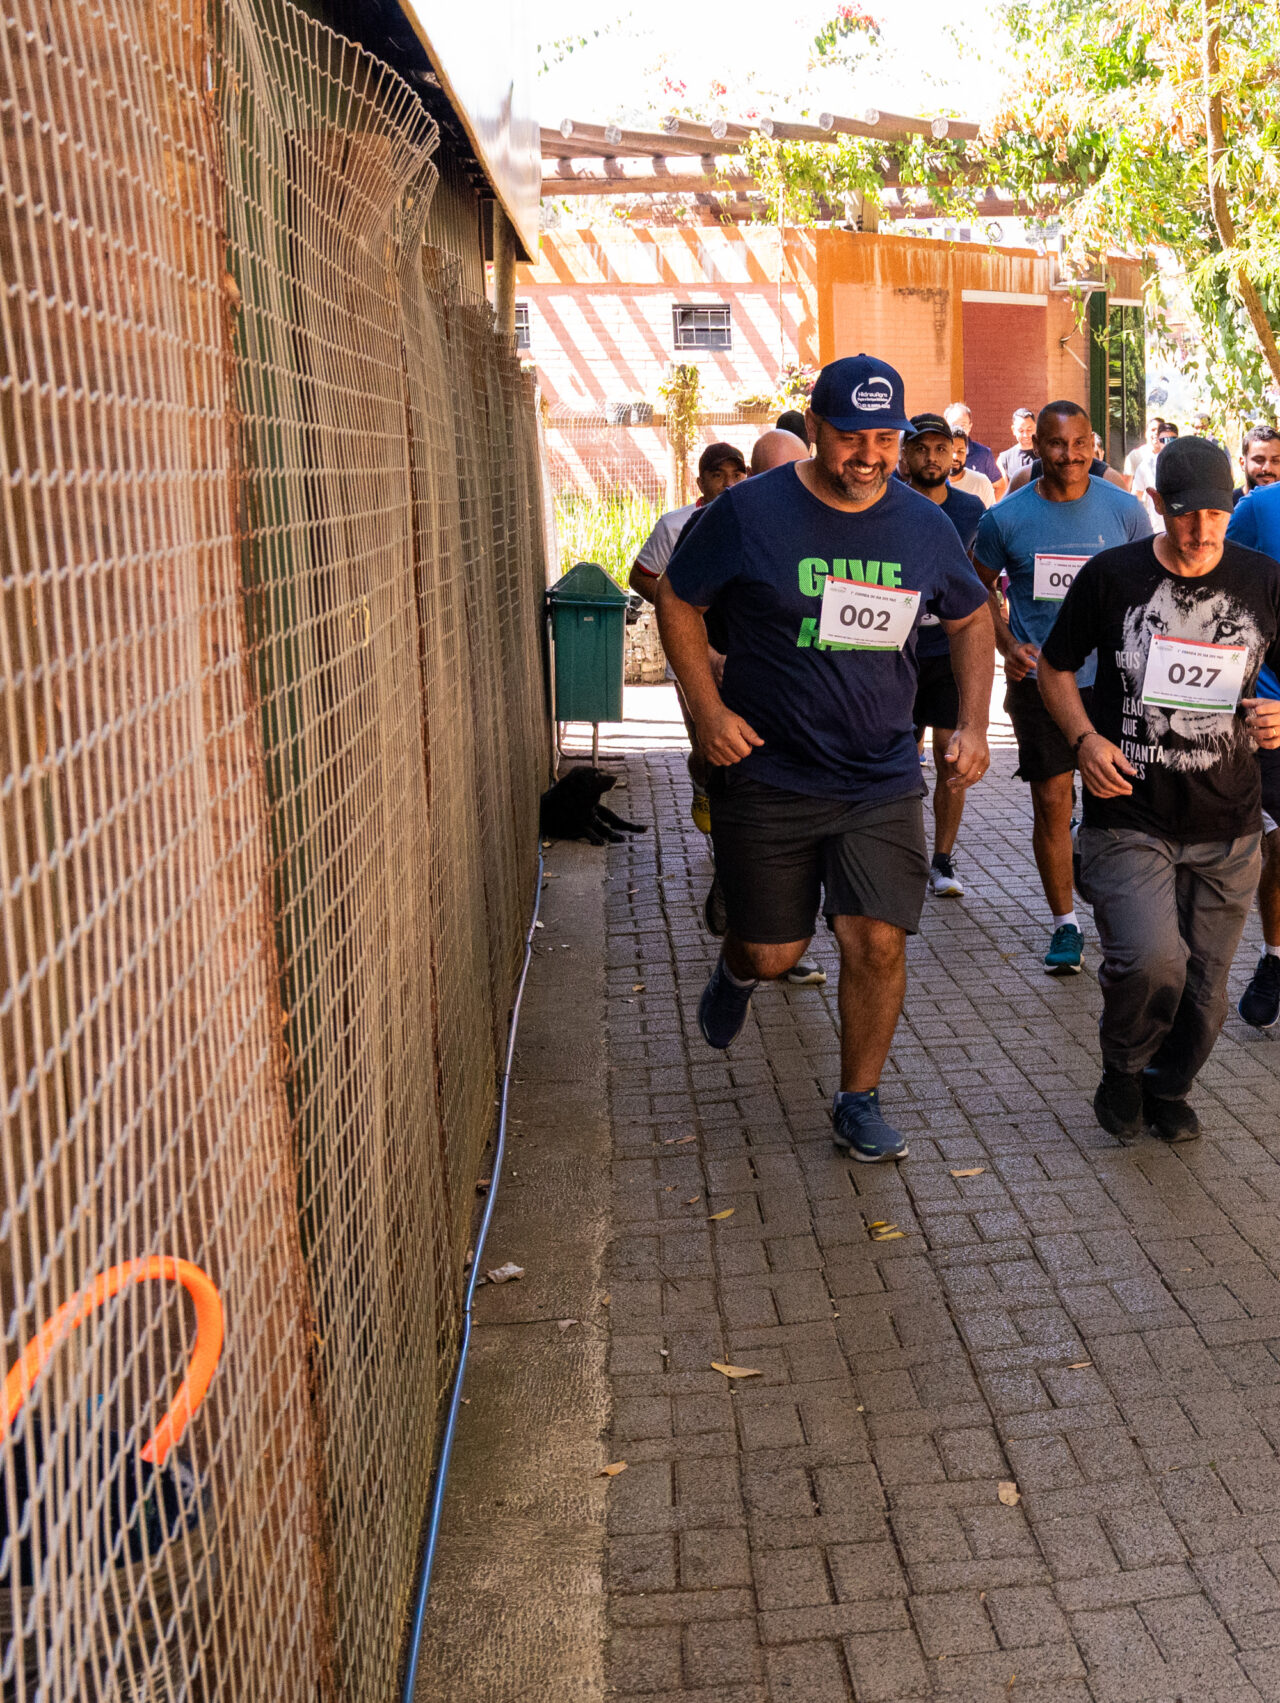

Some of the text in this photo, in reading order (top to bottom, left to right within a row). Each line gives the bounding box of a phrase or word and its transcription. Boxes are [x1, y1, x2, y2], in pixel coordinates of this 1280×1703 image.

[798, 557, 902, 597] GIVE
[1049, 572, 1074, 588] 00
[839, 604, 891, 632] 002
[1115, 650, 1141, 670] DEUS
[1168, 663, 1222, 688] 027
[1121, 717, 1138, 738] QUE
[1120, 739, 1165, 763] LEVANTA
